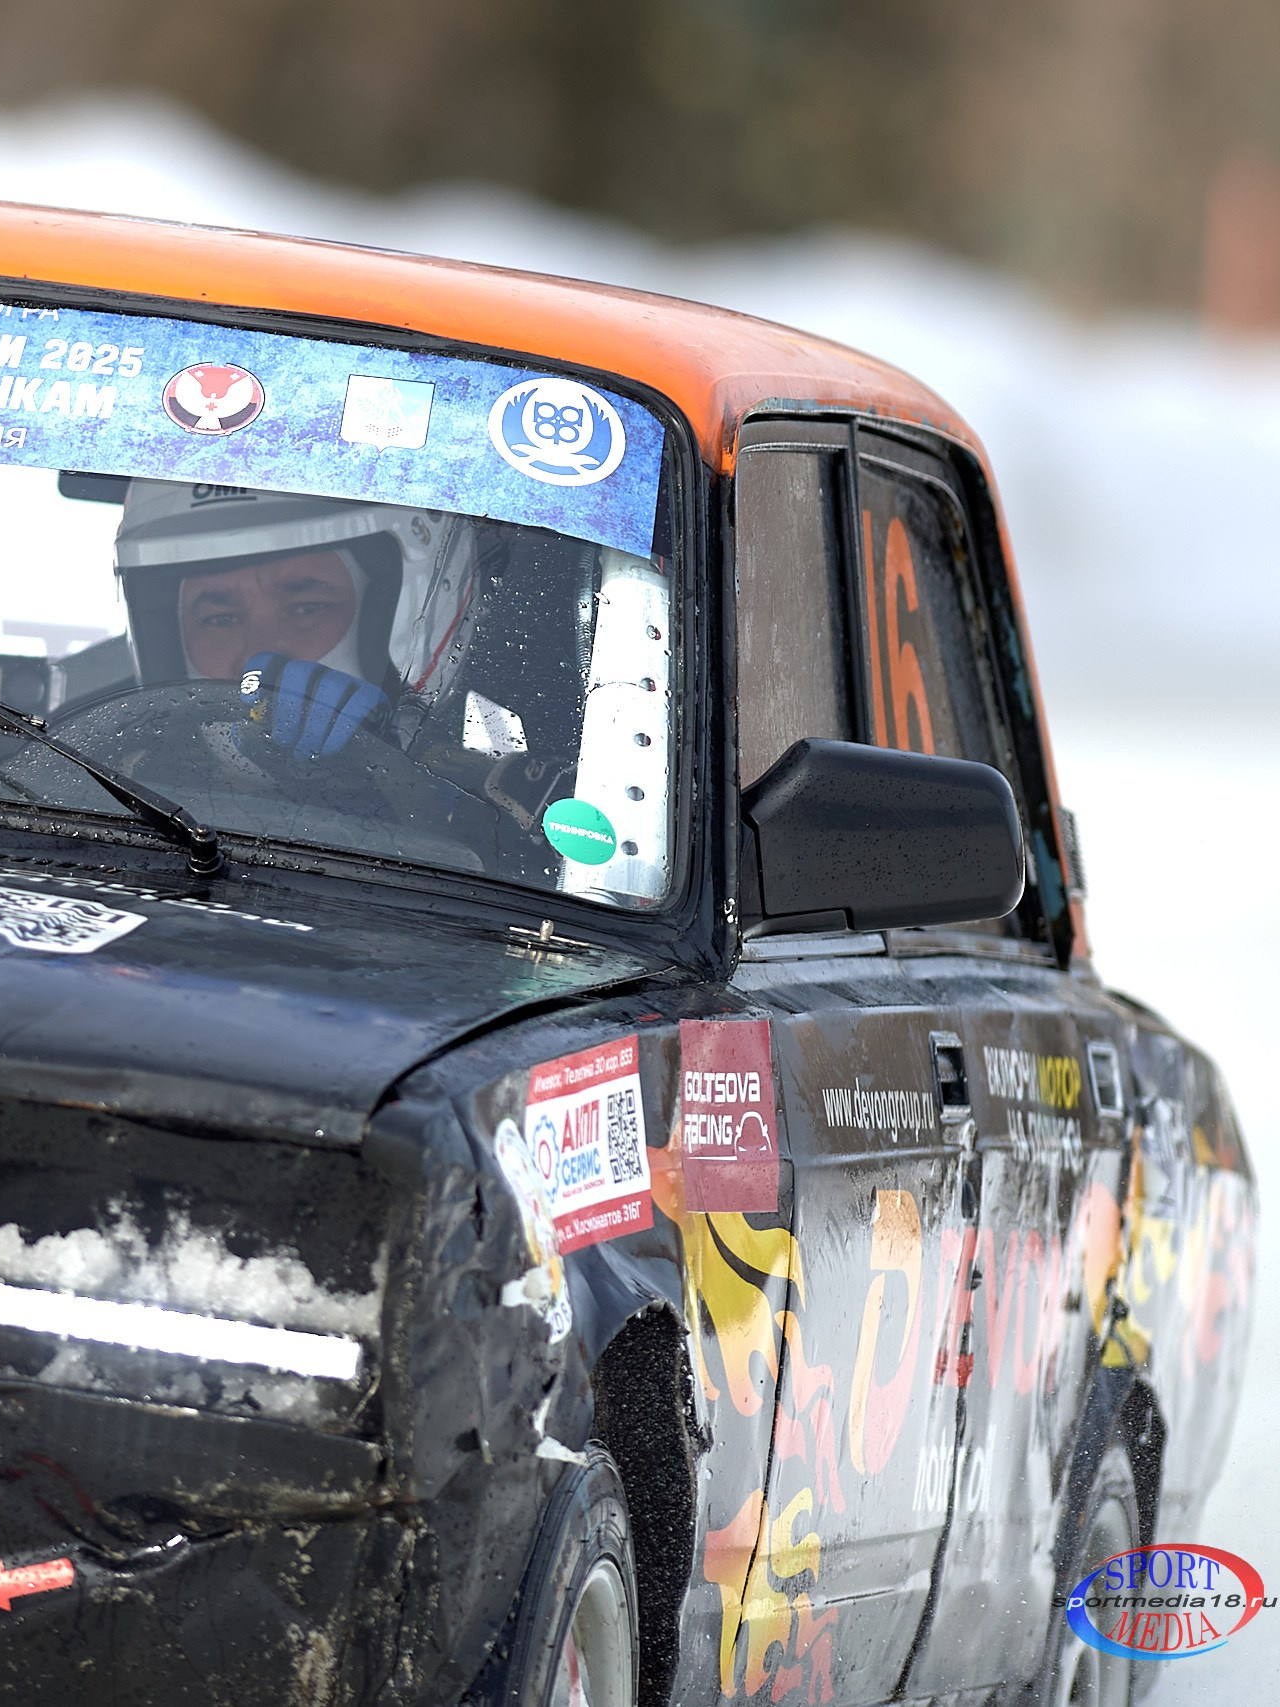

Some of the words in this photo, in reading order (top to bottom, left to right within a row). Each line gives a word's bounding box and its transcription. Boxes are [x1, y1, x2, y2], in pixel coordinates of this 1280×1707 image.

[40, 338, 145, 378] 2025
[561, 1099, 600, 1153] АКПП
[822, 1077, 935, 1142] www.devongroup.ru
[562, 1147, 601, 1186] СЕРВИС
